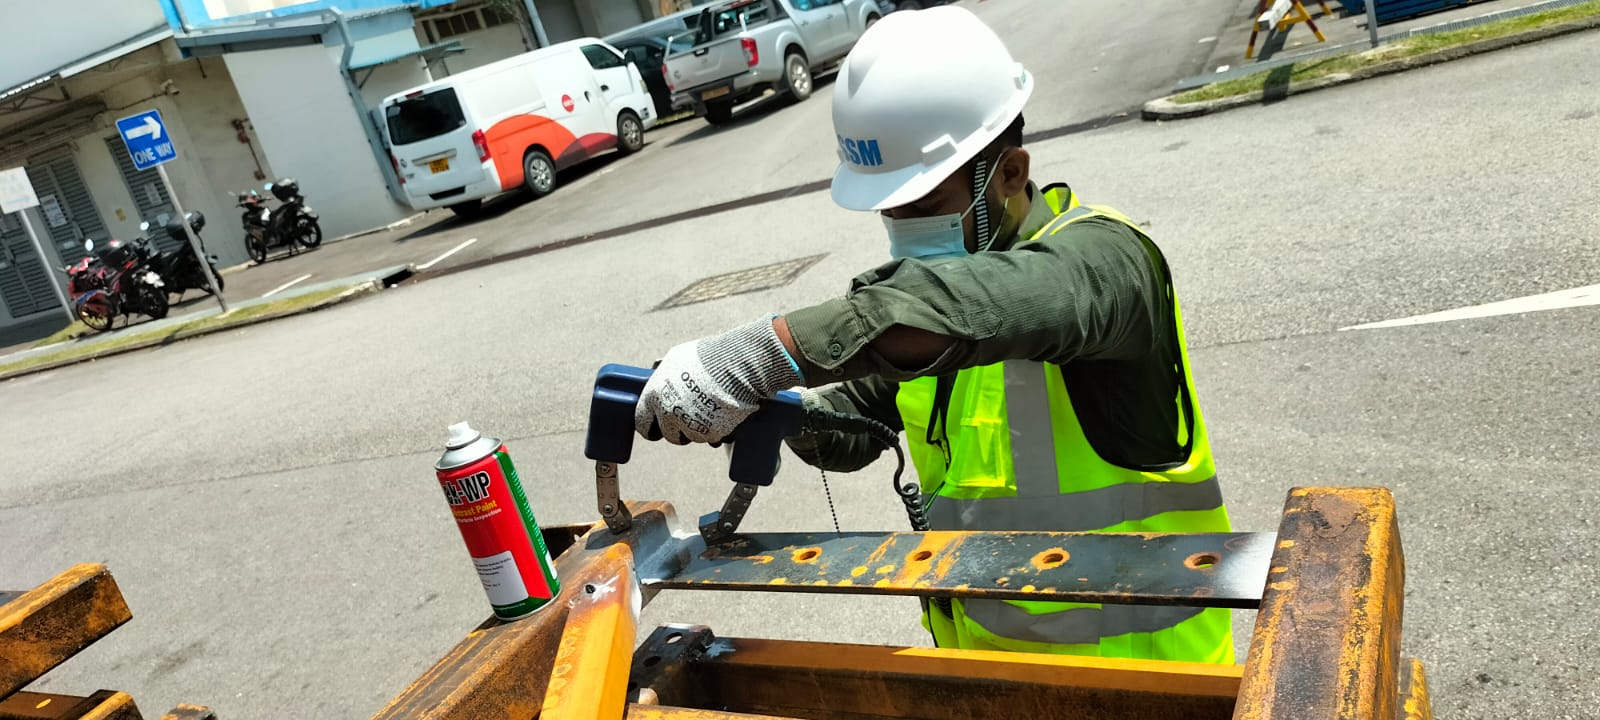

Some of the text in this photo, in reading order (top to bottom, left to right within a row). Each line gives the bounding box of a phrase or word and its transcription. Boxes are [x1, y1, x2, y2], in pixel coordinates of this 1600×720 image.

[134, 142, 173, 165] ONE WAY
[681, 371, 721, 412] OSPREY
[476, 499, 498, 513] Paint
